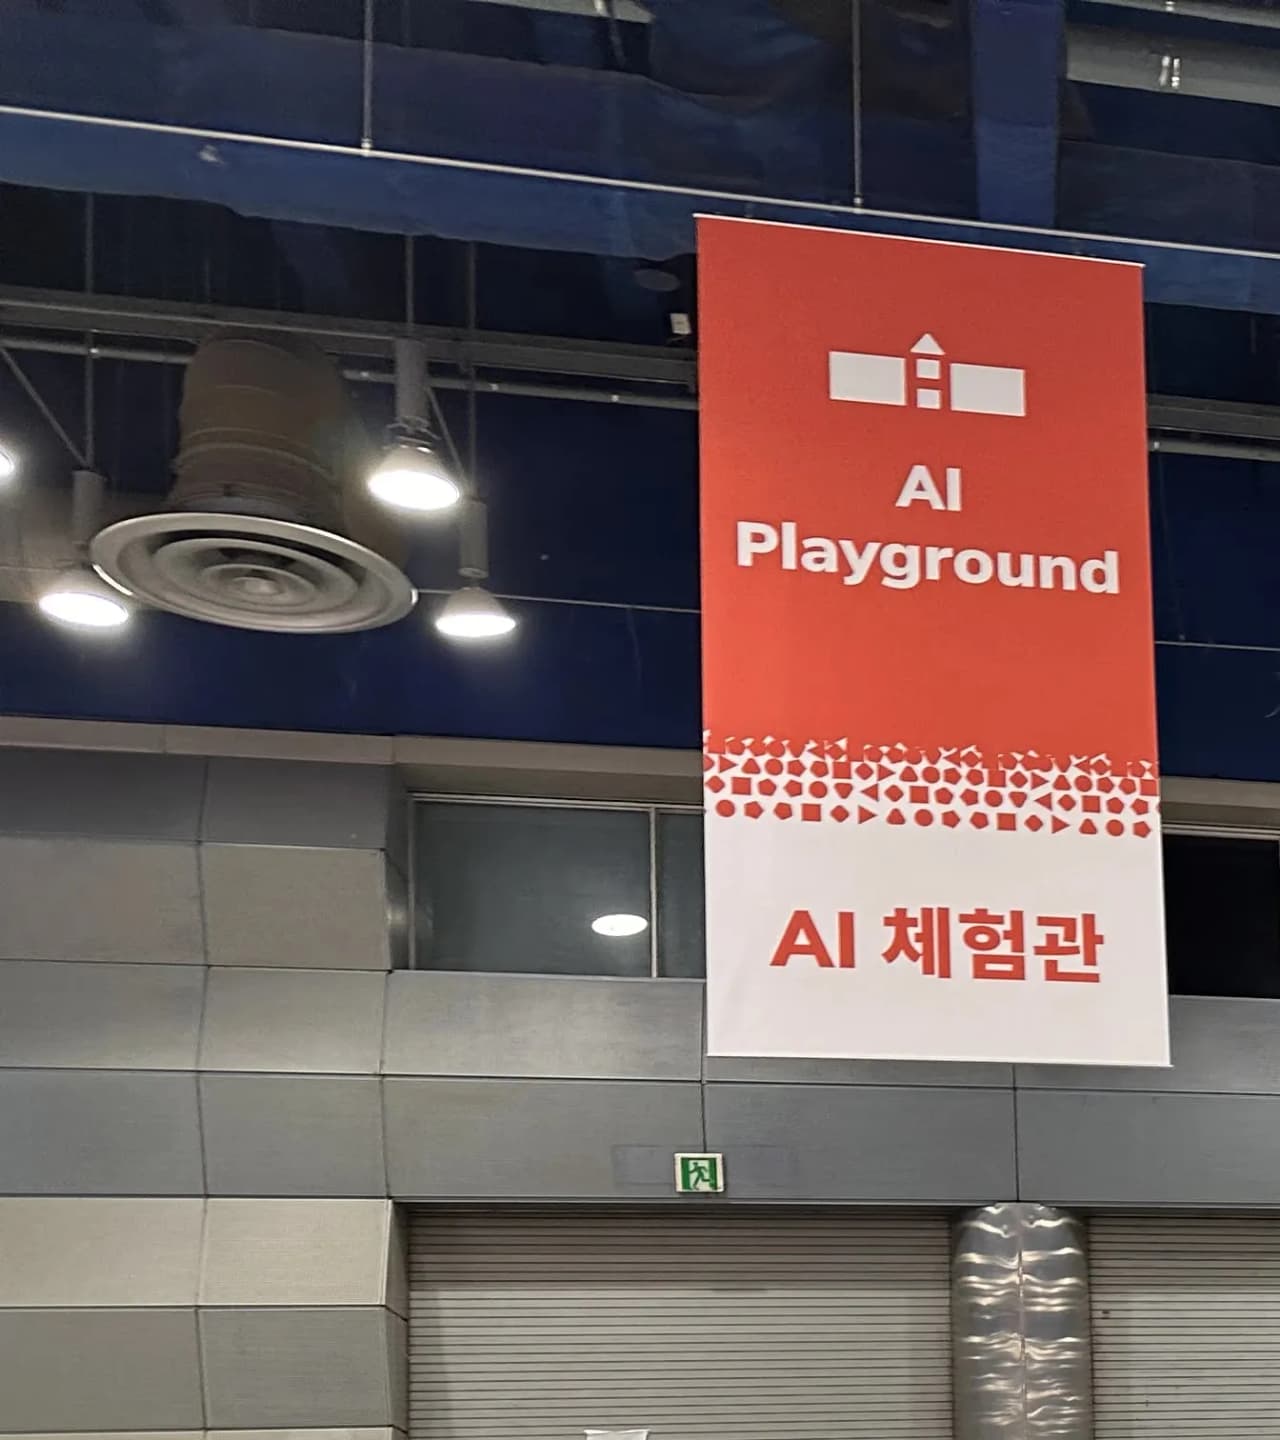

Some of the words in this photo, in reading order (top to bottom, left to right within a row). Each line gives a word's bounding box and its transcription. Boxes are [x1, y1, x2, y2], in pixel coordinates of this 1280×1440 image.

[896, 465, 962, 511] AI
[736, 521, 1120, 594] Playground
[769, 910, 855, 968] AI
[882, 907, 1104, 983] 체험관
